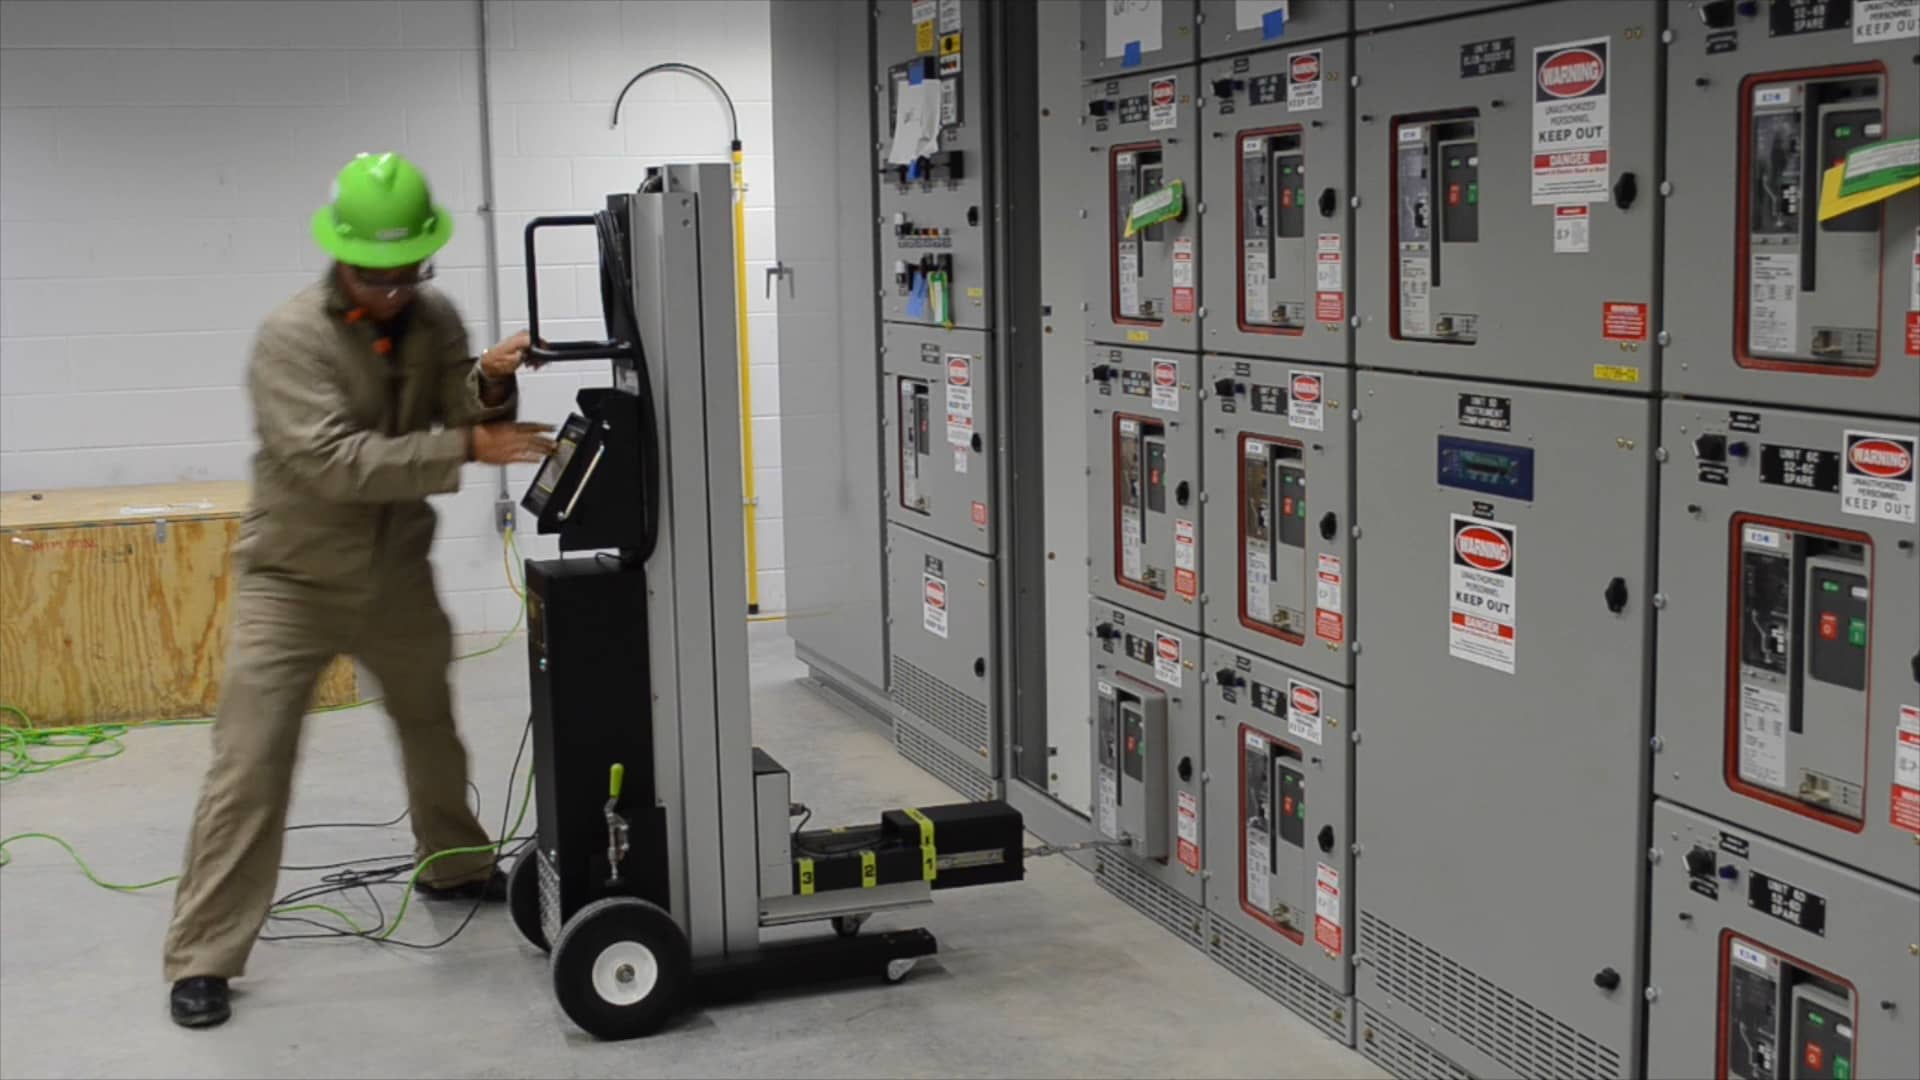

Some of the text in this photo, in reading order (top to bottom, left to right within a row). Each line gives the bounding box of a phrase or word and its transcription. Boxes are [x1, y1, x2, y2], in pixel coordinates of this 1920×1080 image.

[1857, 19, 1920, 35] KEEP OU
[1542, 61, 1599, 85] WARNING
[1538, 126, 1603, 142] KEEP OUT
[1779, 448, 1800, 460] UNIT
[1855, 447, 1906, 468] WARNING
[1784, 473, 1815, 487] SPARE
[1846, 498, 1911, 516] KEEP OUT
[1456, 591, 1510, 615] KEEP OUT
[802, 872, 812, 884] 3
[864, 865, 874, 878] 2
